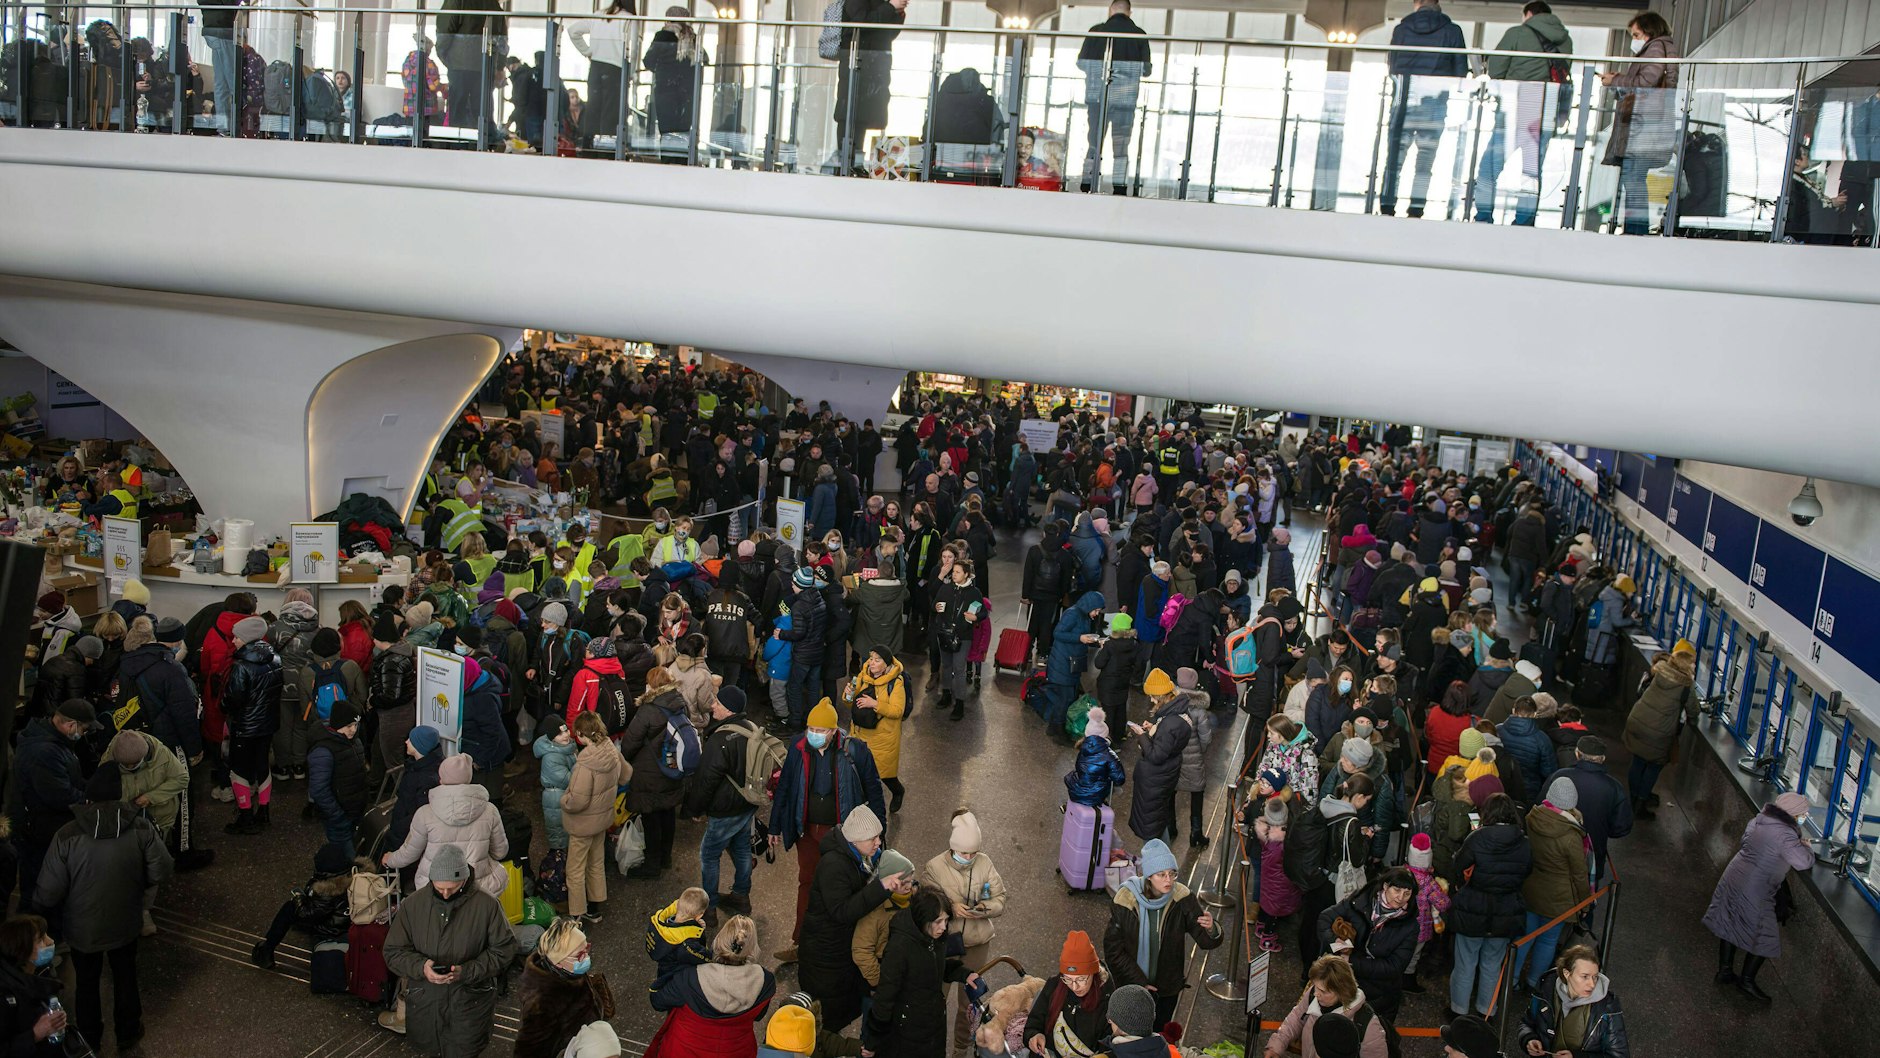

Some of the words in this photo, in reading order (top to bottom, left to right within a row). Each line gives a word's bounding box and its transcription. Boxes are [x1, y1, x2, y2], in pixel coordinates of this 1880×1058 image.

[1701, 556, 1708, 572] 12
[1748, 591, 1756, 609] 13
[1811, 641, 1821, 664] 14
